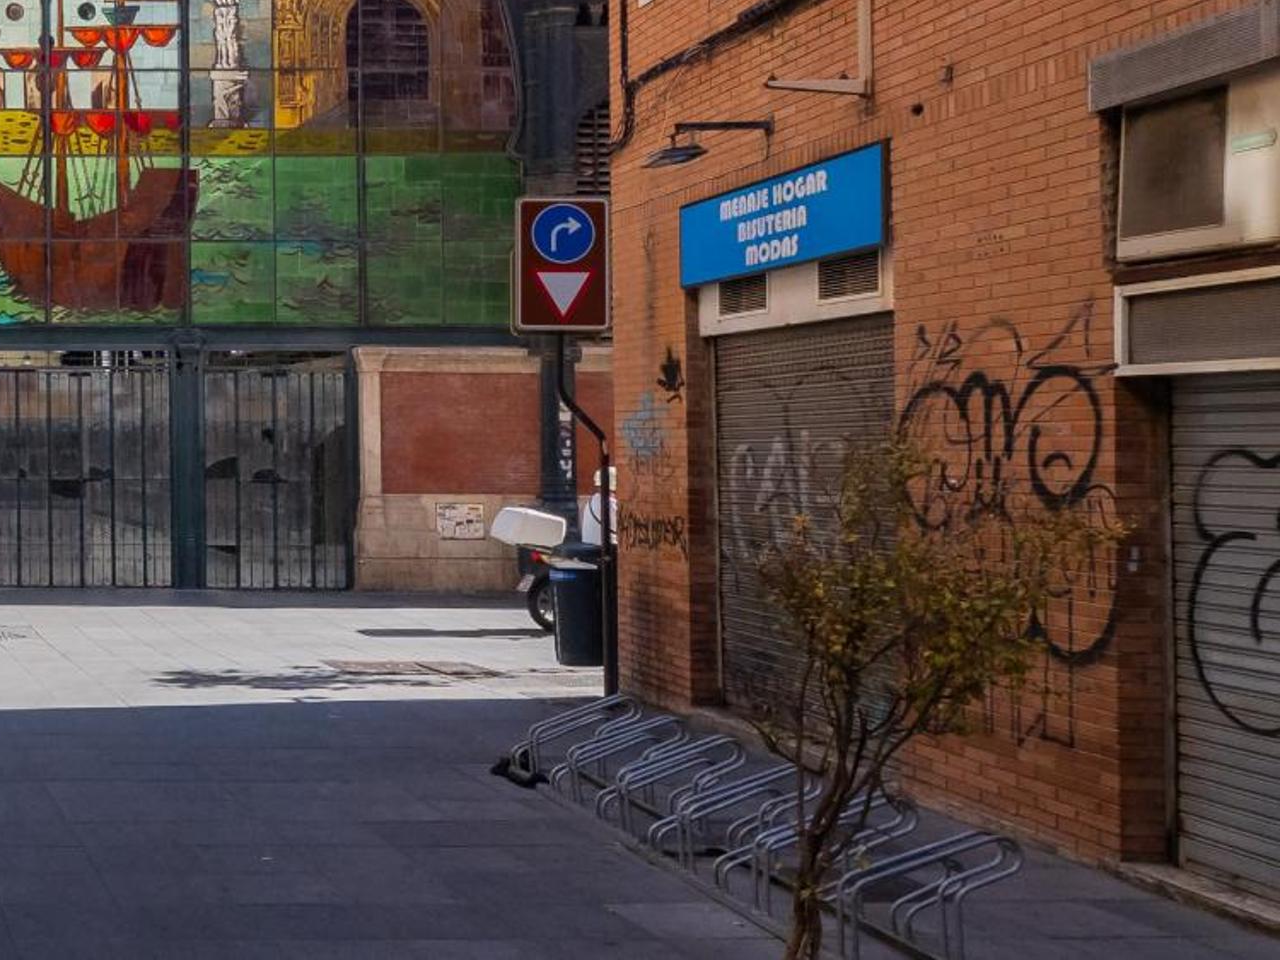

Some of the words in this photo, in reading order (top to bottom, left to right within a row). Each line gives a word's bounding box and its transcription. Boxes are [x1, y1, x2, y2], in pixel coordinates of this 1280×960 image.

[719, 188, 770, 221] MENAJE
[772, 170, 828, 206] HOGAR
[737, 205, 807, 242] BISUTERIA
[745, 234, 799, 266] MODAS
